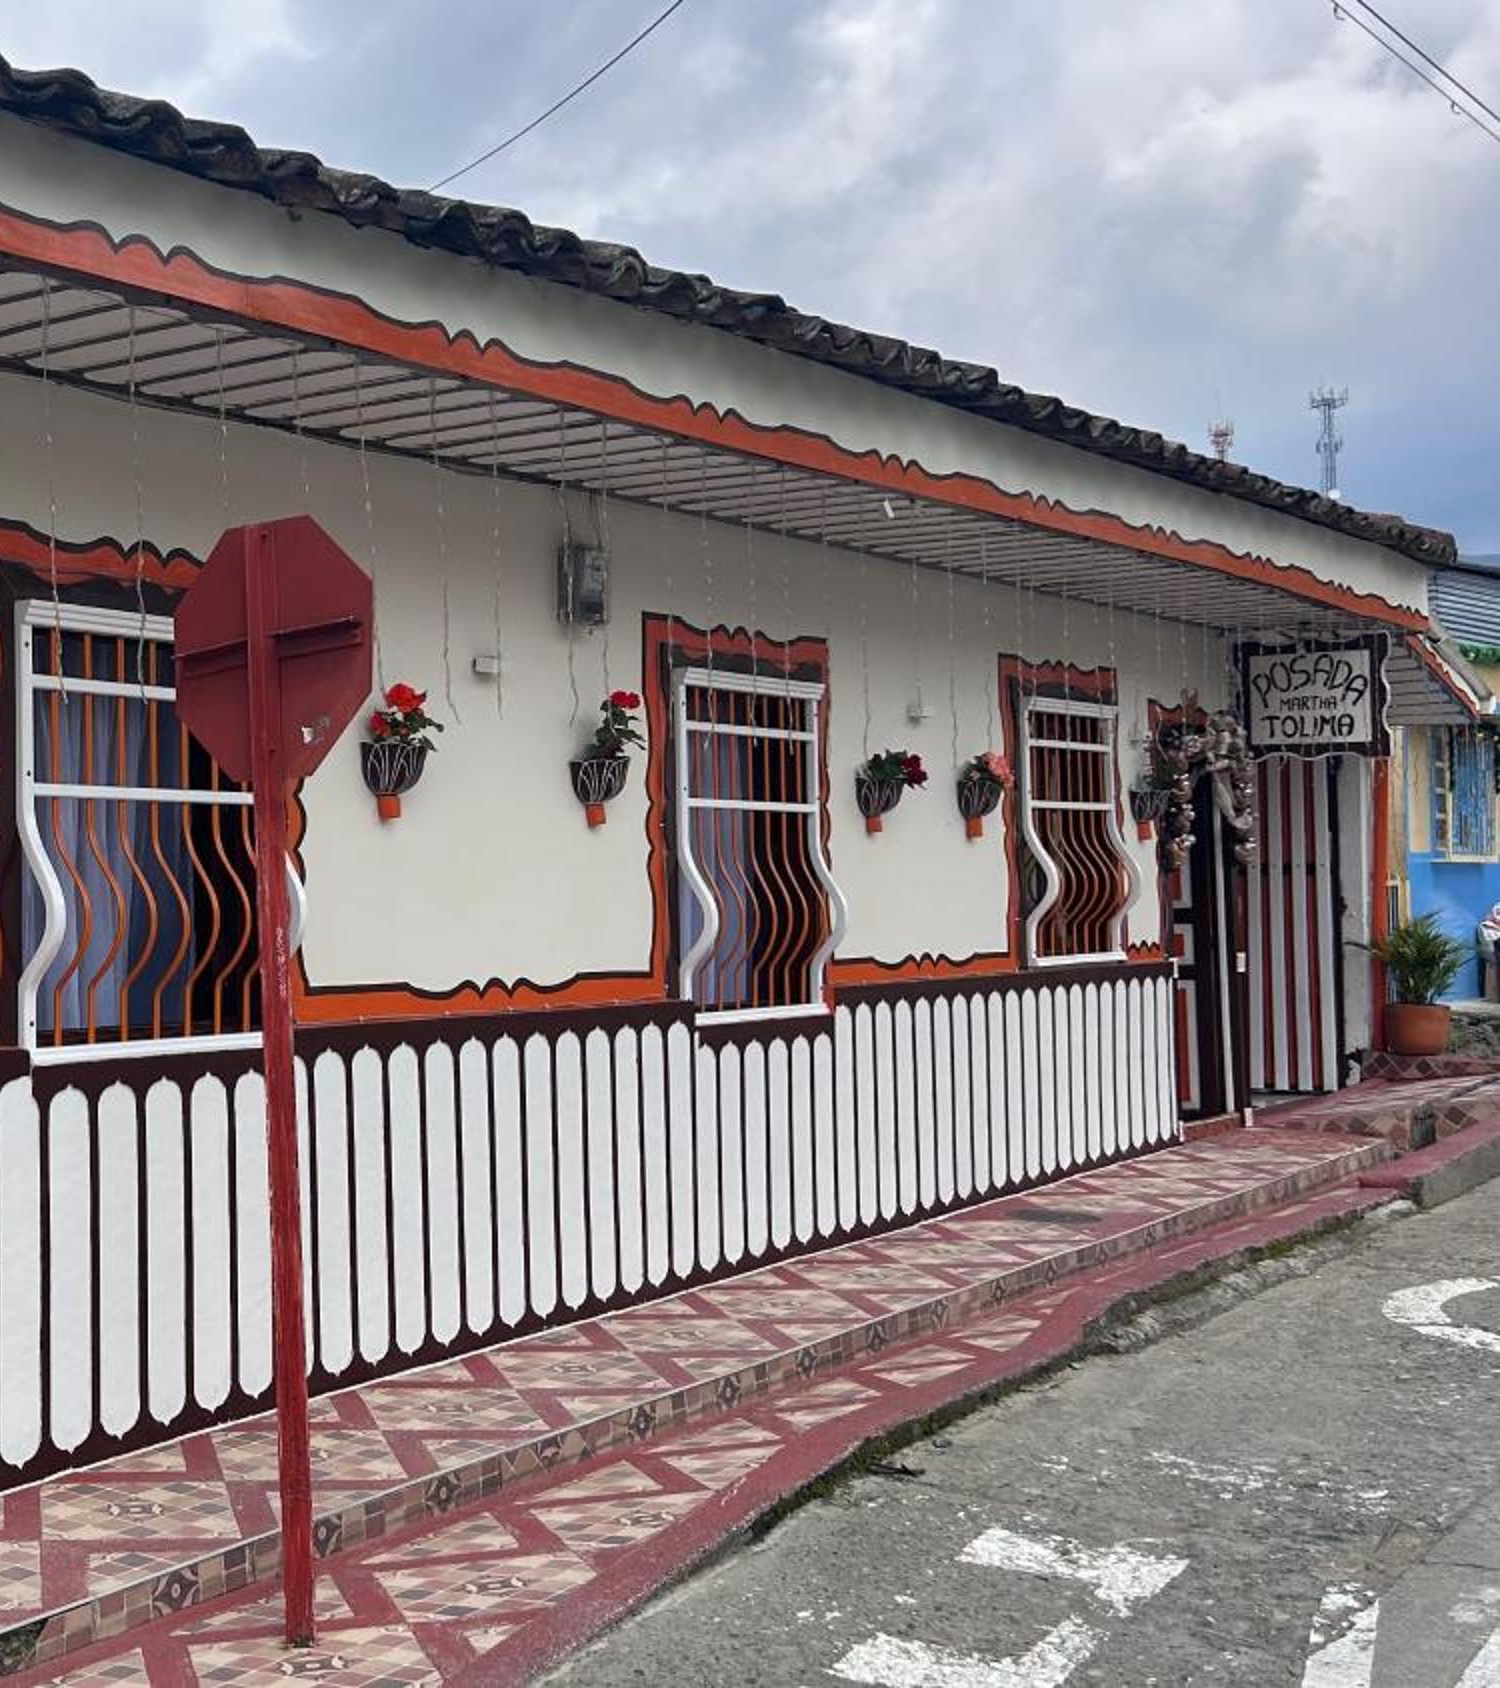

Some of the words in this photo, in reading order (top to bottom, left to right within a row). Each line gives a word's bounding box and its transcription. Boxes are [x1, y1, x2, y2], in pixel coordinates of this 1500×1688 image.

[1251, 653, 1369, 709] POSADA
[1279, 695, 1337, 711] MARTHA
[1260, 714, 1355, 738] TOLIMA
